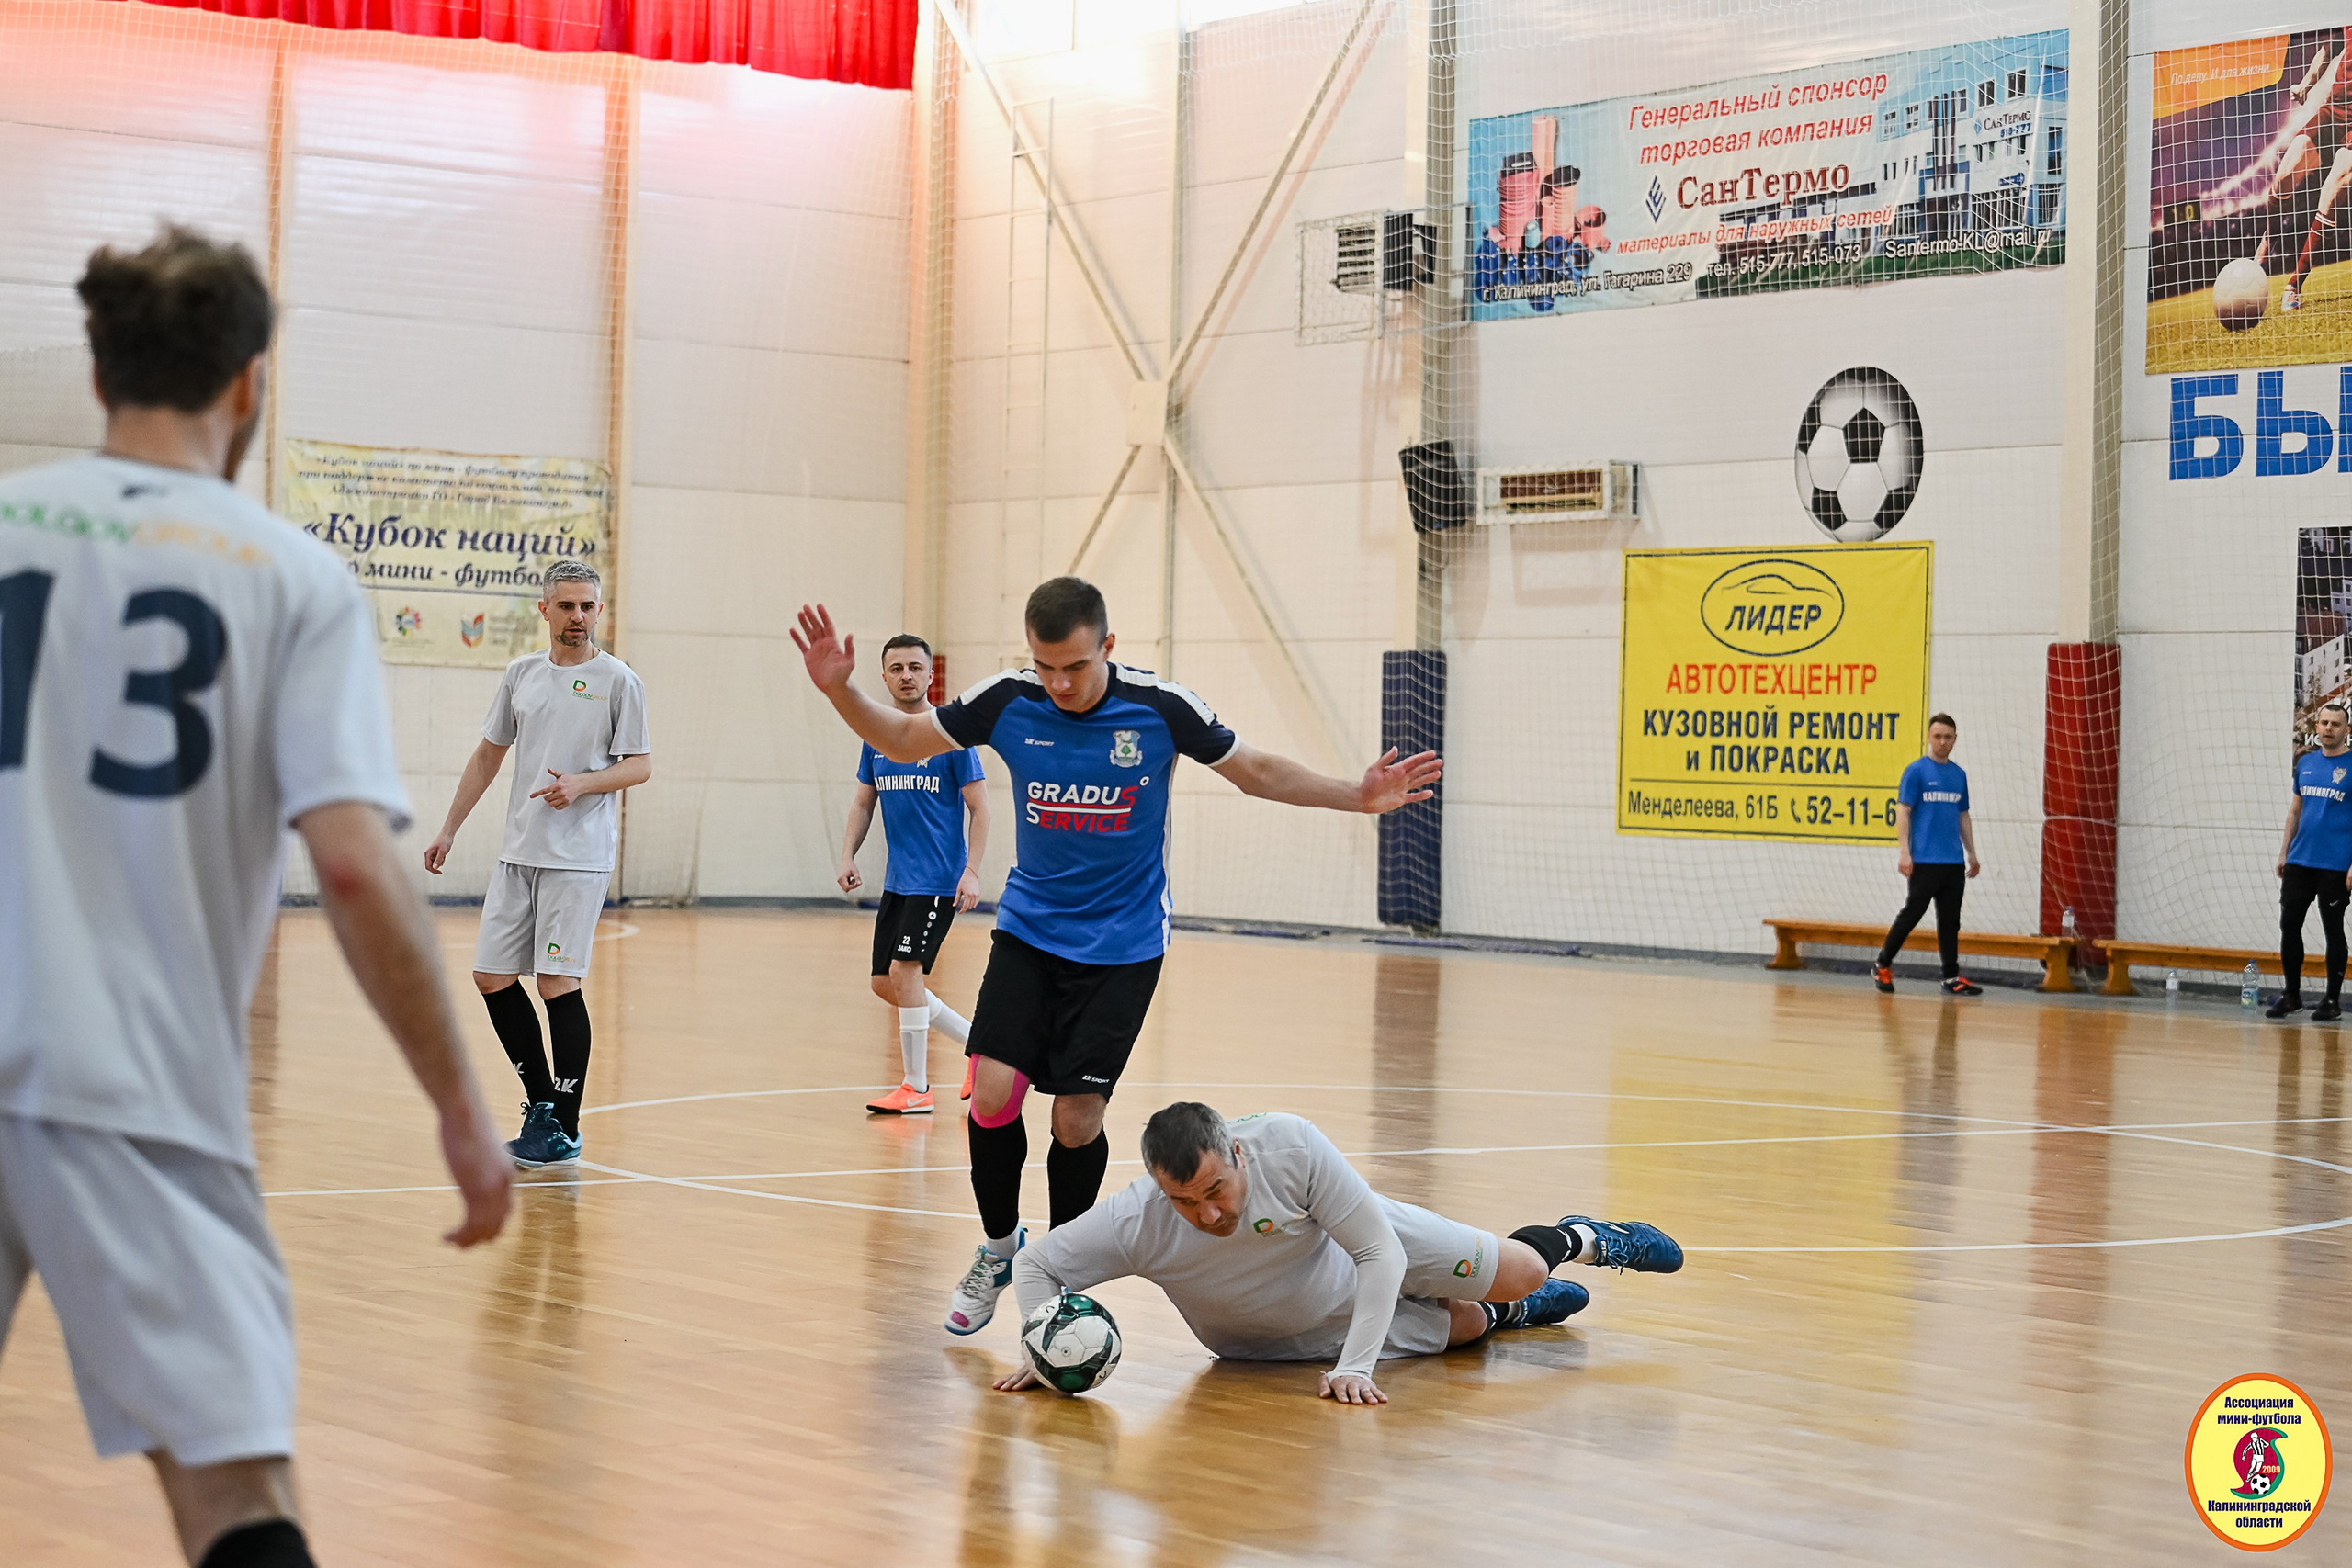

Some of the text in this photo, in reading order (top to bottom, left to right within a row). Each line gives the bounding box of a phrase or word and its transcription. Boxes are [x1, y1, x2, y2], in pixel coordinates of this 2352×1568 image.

[2220, 67, 2237, 79] для
[2240, 64, 2270, 76] жизни
[1628, 73, 1888, 130] Генеральный спонсор
[1640, 113, 1873, 166] торговая компания
[1677, 163, 1850, 209] СанТермо
[1617, 205, 1894, 254] материалы для наружных сетей
[1706, 260, 1736, 277] тел.
[1801, 244, 1861, 268] 515-073
[1580, 275, 1601, 296] ул.
[1603, 268, 1664, 291] Гагарина
[1666, 262, 1692, 283] 229
[303, 513, 447, 554] «Кубок
[457, 524, 596, 563] наций»
[365, 562, 433, 581] мини
[454, 562, 544, 589] футбо
[1724, 604, 1822, 635] ЛИДЕР
[1665, 663, 1877, 700] АВТОТЕХЦЕНТР
[1643, 705, 1900, 740] КУЗОВНОЙ РЕМОНТ
[1685, 745, 1850, 775] и ПОКРАСКА
[1026, 801, 1131, 833] SERVICE
[1628, 790, 1738, 822] Менделеева,
[1746, 795, 1778, 819] 61Б
[897, 944, 912, 953] JAKO
[902, 935, 910, 945] 22
